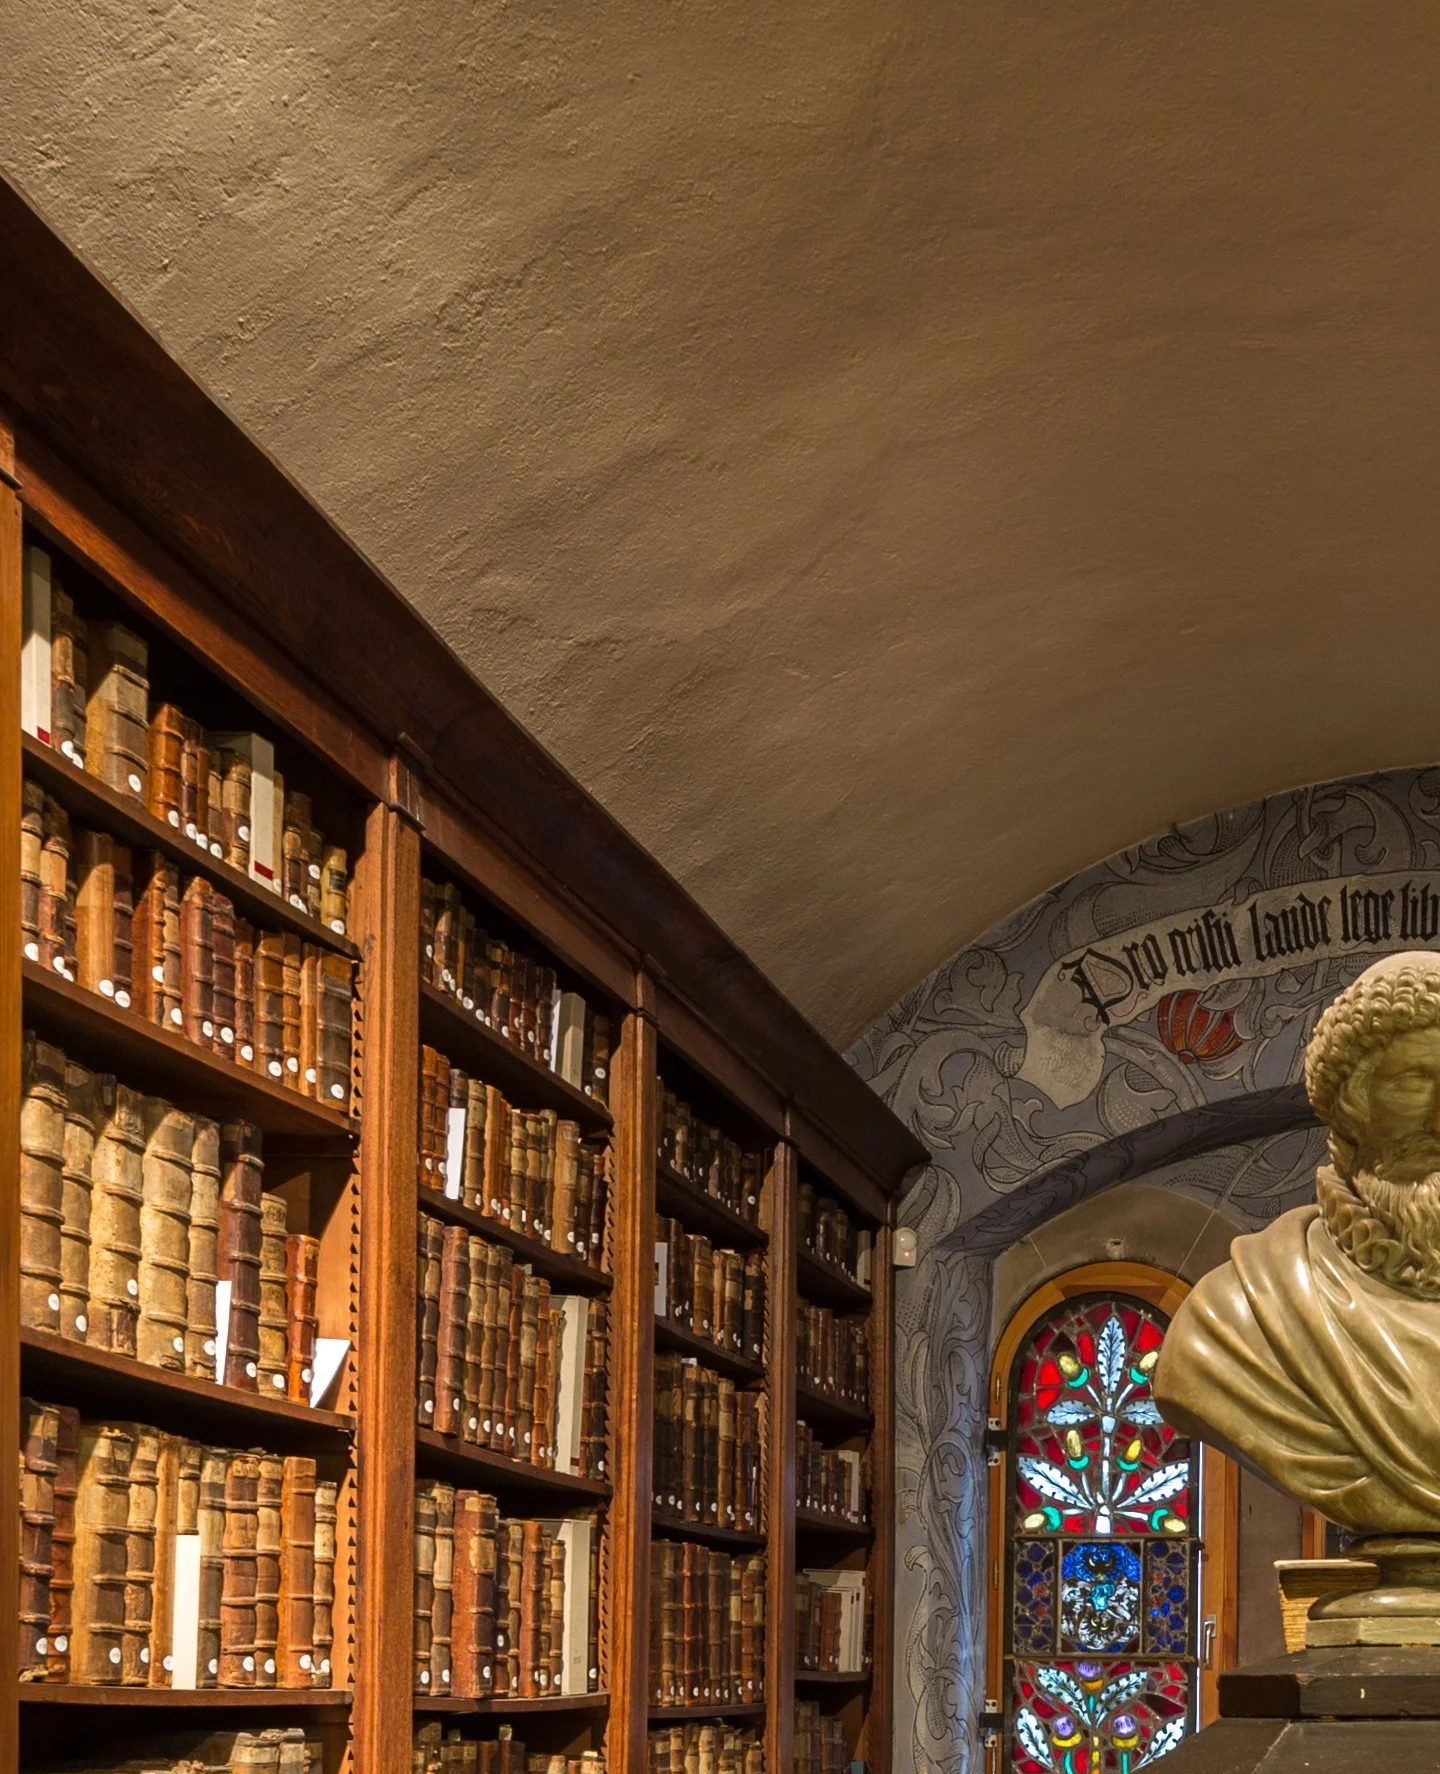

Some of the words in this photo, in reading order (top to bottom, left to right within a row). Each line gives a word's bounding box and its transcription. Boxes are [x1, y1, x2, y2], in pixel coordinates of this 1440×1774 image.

[1059, 933, 1169, 1026] Pro
[1247, 892, 1332, 962] laude
[1339, 885, 1395, 950] lege
